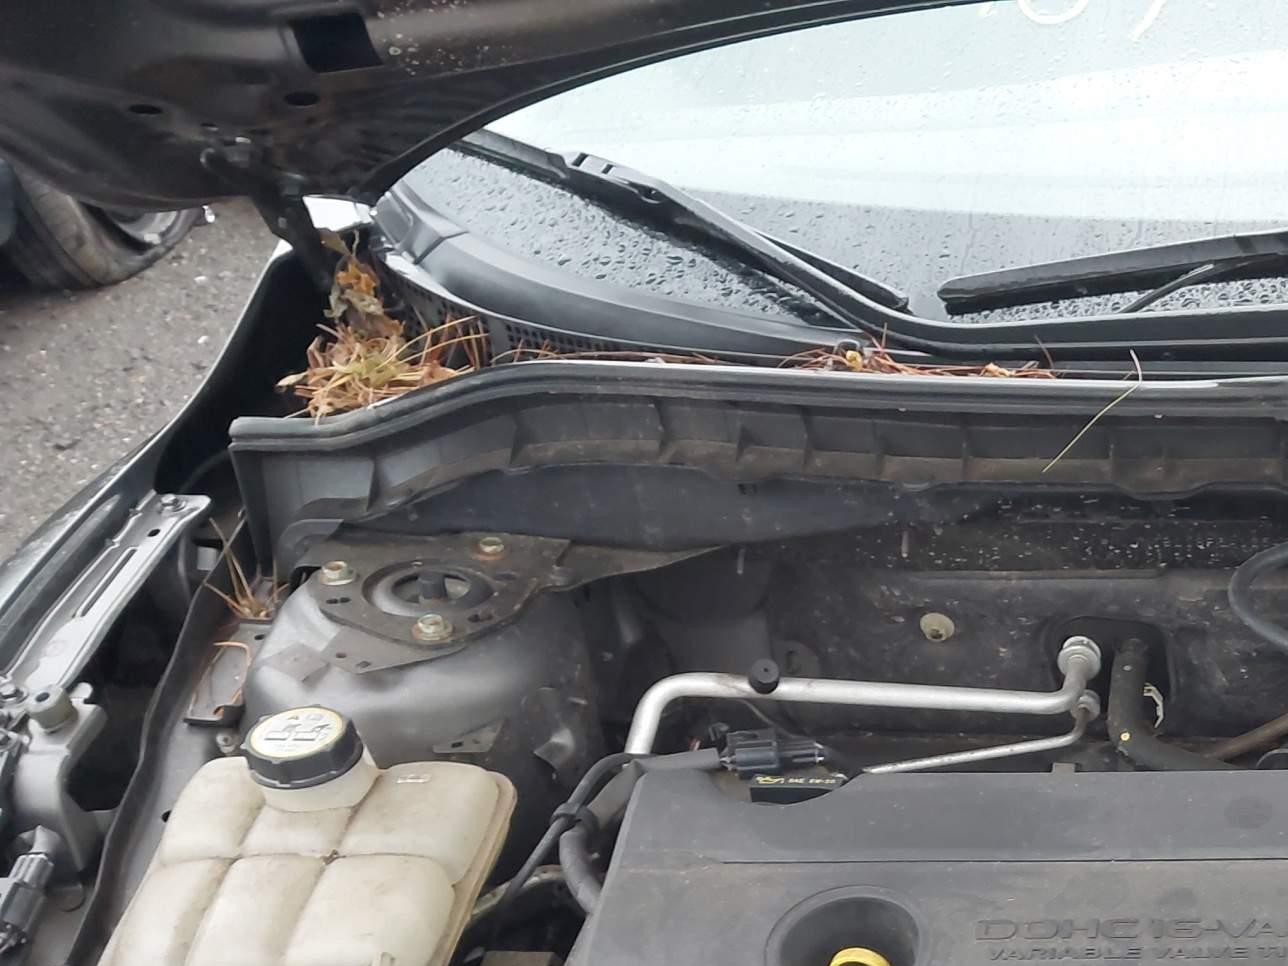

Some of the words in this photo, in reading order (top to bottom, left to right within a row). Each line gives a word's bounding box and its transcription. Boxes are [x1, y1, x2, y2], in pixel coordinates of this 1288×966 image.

[975, 918, 1140, 941] DOHC
[989, 946, 1144, 961] VARIABLE
[1153, 946, 1250, 960] VALVE
